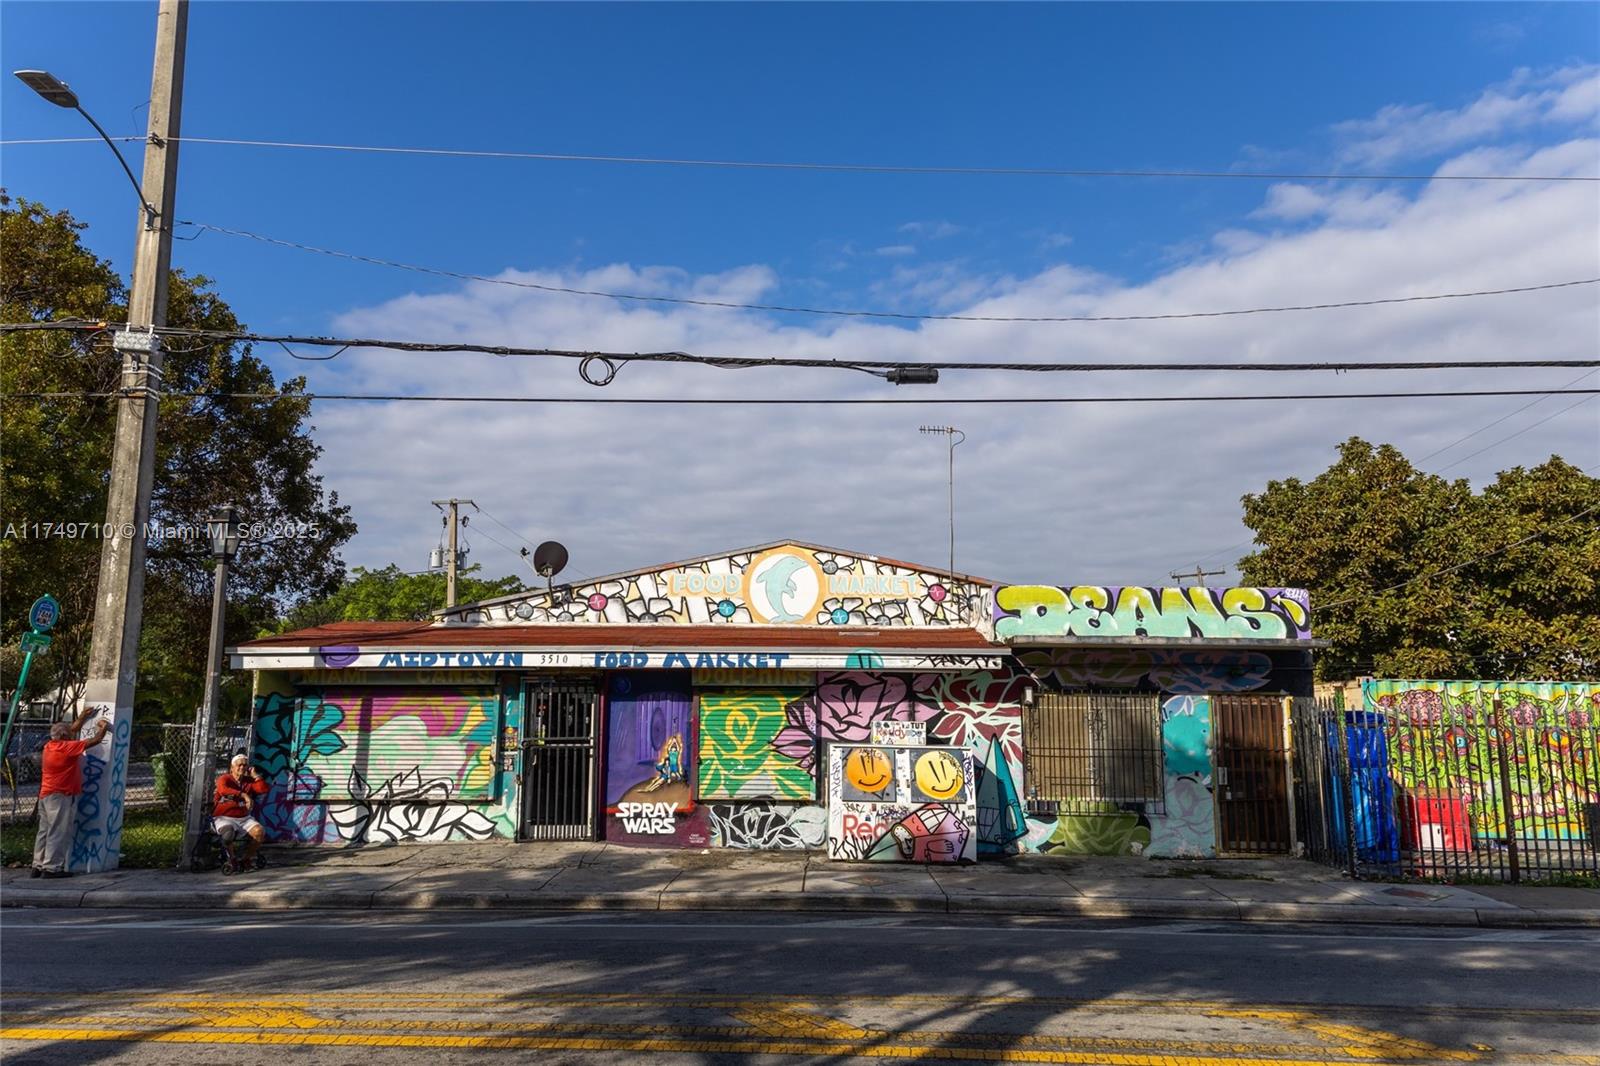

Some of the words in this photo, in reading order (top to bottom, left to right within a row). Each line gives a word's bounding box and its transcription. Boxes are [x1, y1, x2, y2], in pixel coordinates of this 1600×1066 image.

[671, 573, 742, 595] FOOD
[828, 574, 919, 596] MARKET
[379, 652, 523, 667] MIDTOWN
[540, 654, 568, 665] 3510
[595, 652, 648, 668] FOOD
[662, 652, 790, 668] MARKET
[303, 669, 368, 684] MIAMI
[416, 669, 491, 684] CANES
[698, 668, 811, 684] DOLPHINS
[615, 802, 678, 818] SPRAY
[622, 818, 676, 834] WARS
